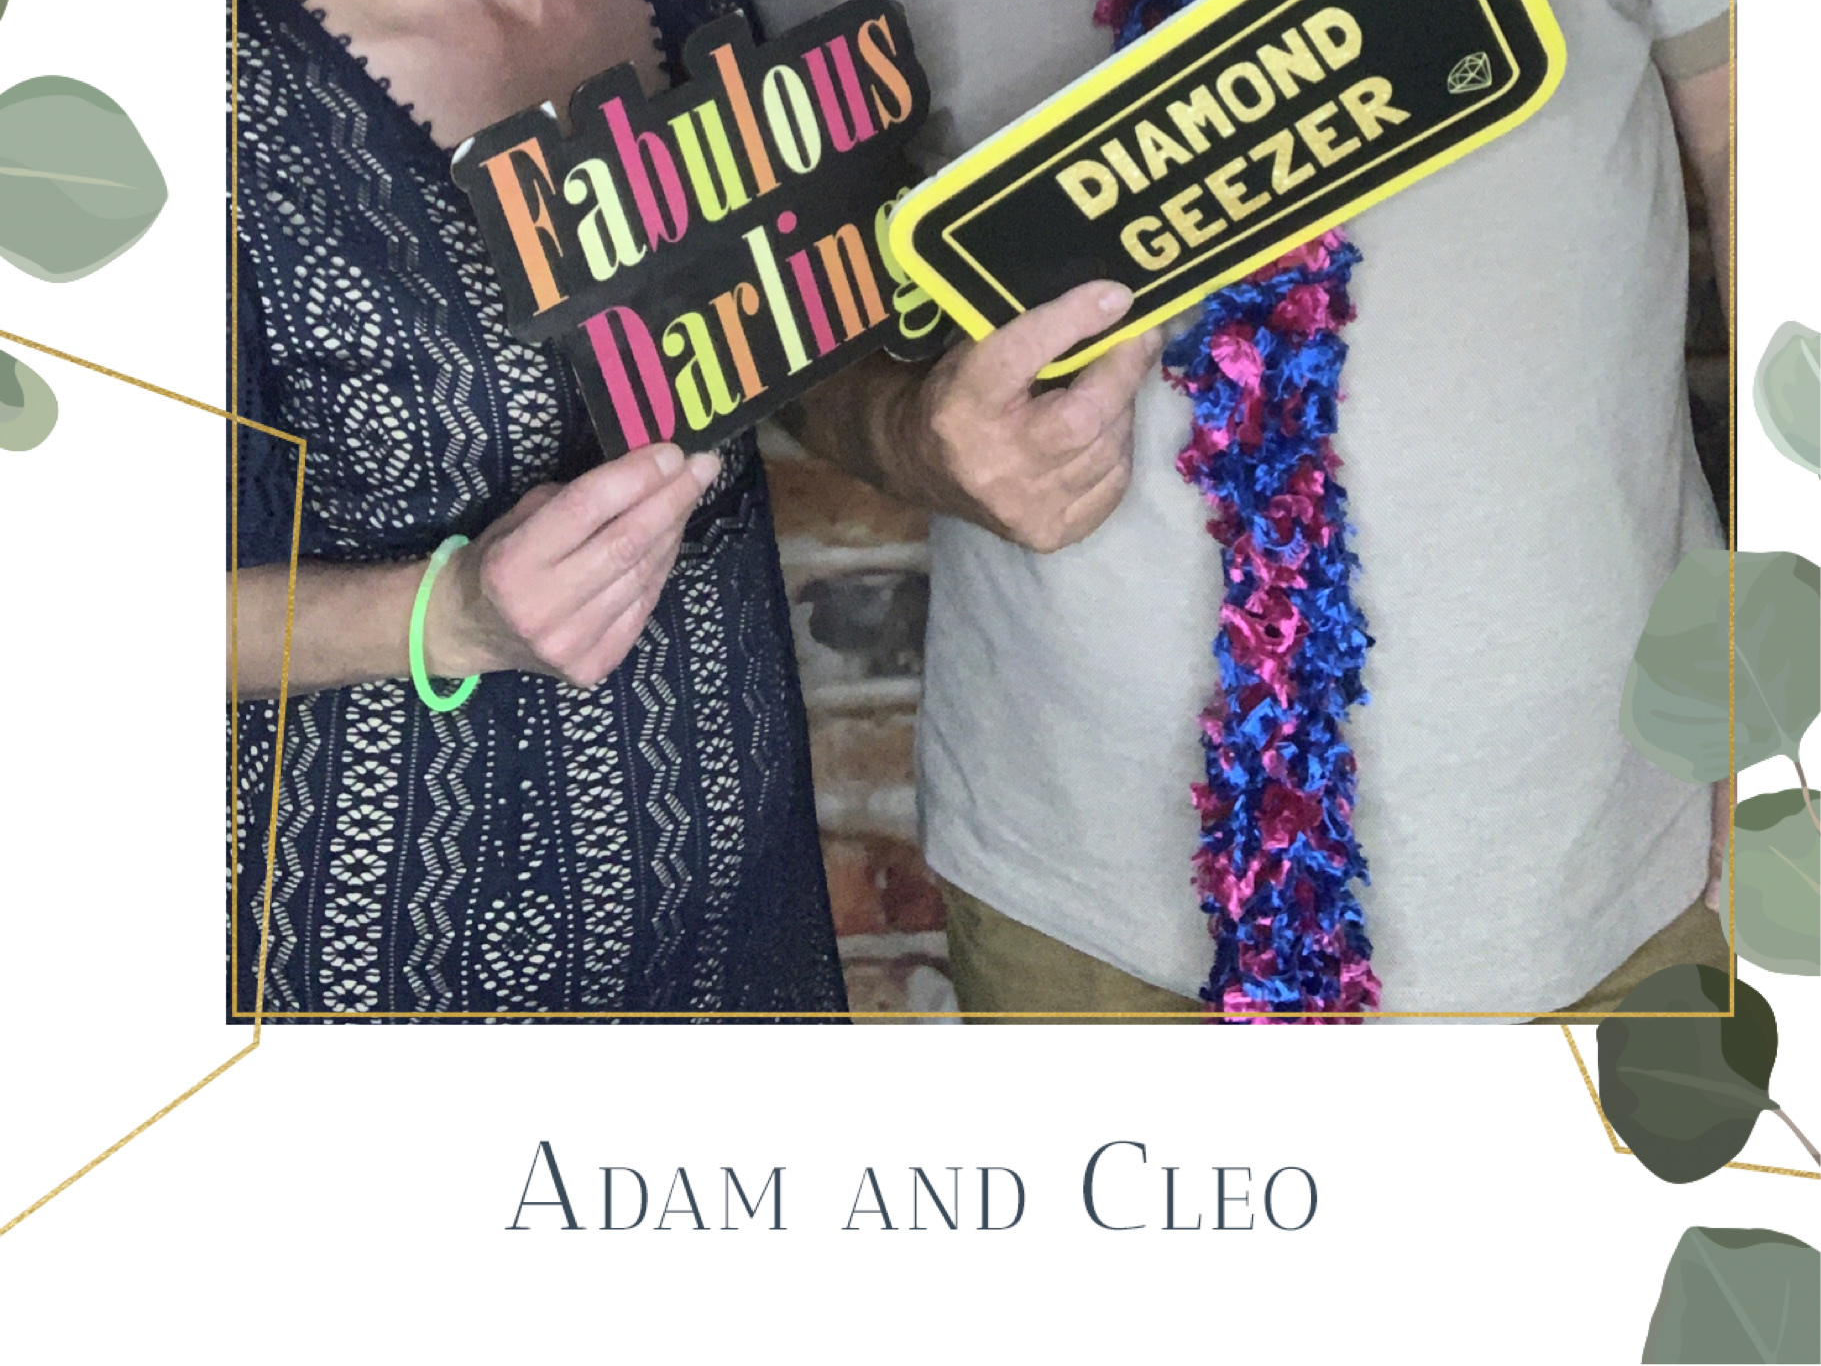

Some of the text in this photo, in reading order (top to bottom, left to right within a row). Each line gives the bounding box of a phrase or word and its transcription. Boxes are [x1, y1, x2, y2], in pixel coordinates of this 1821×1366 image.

[479, 14, 913, 318] Fabulous
[1055, 6, 1363, 220] DIAMOND
[1119, 76, 1411, 271] GEEZER
